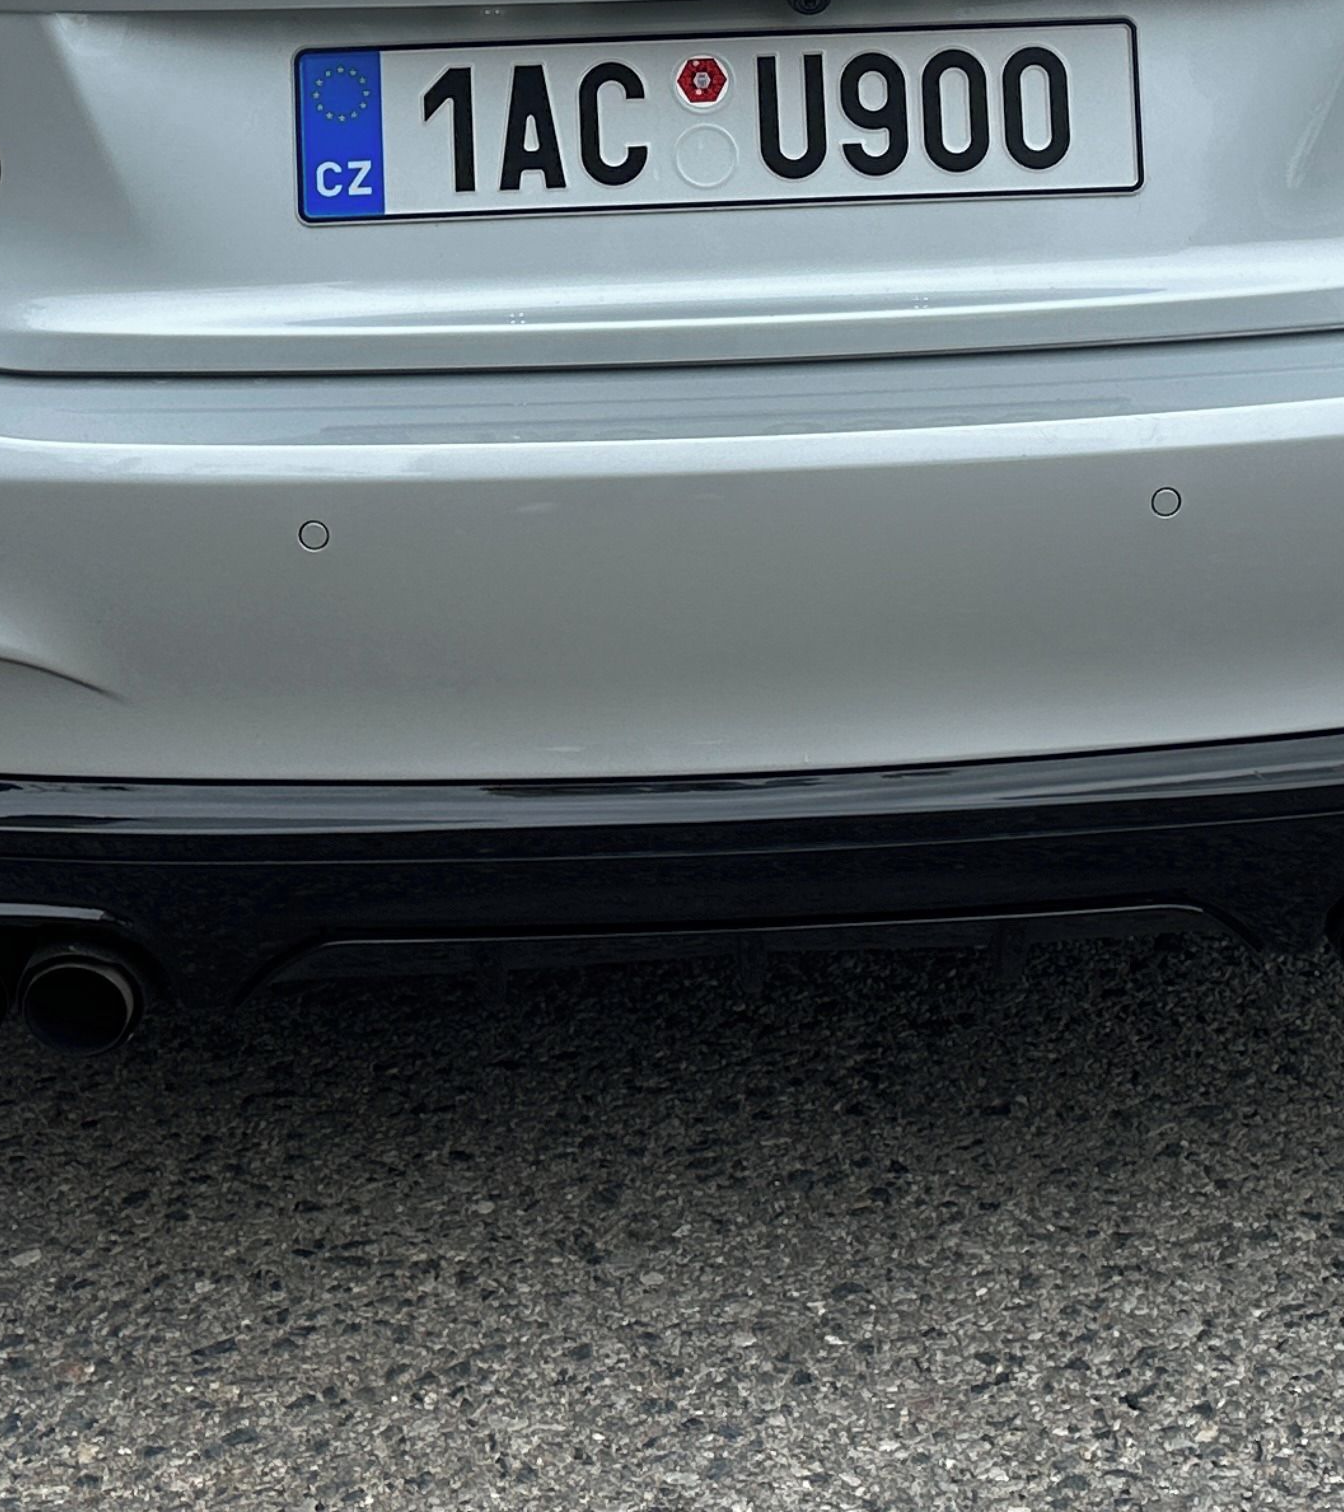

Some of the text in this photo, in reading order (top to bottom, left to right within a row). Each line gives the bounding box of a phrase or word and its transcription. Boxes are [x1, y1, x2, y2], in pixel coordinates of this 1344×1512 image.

[423, 46, 1071, 194] 1AC U900
[316, 159, 374, 198] CZ
